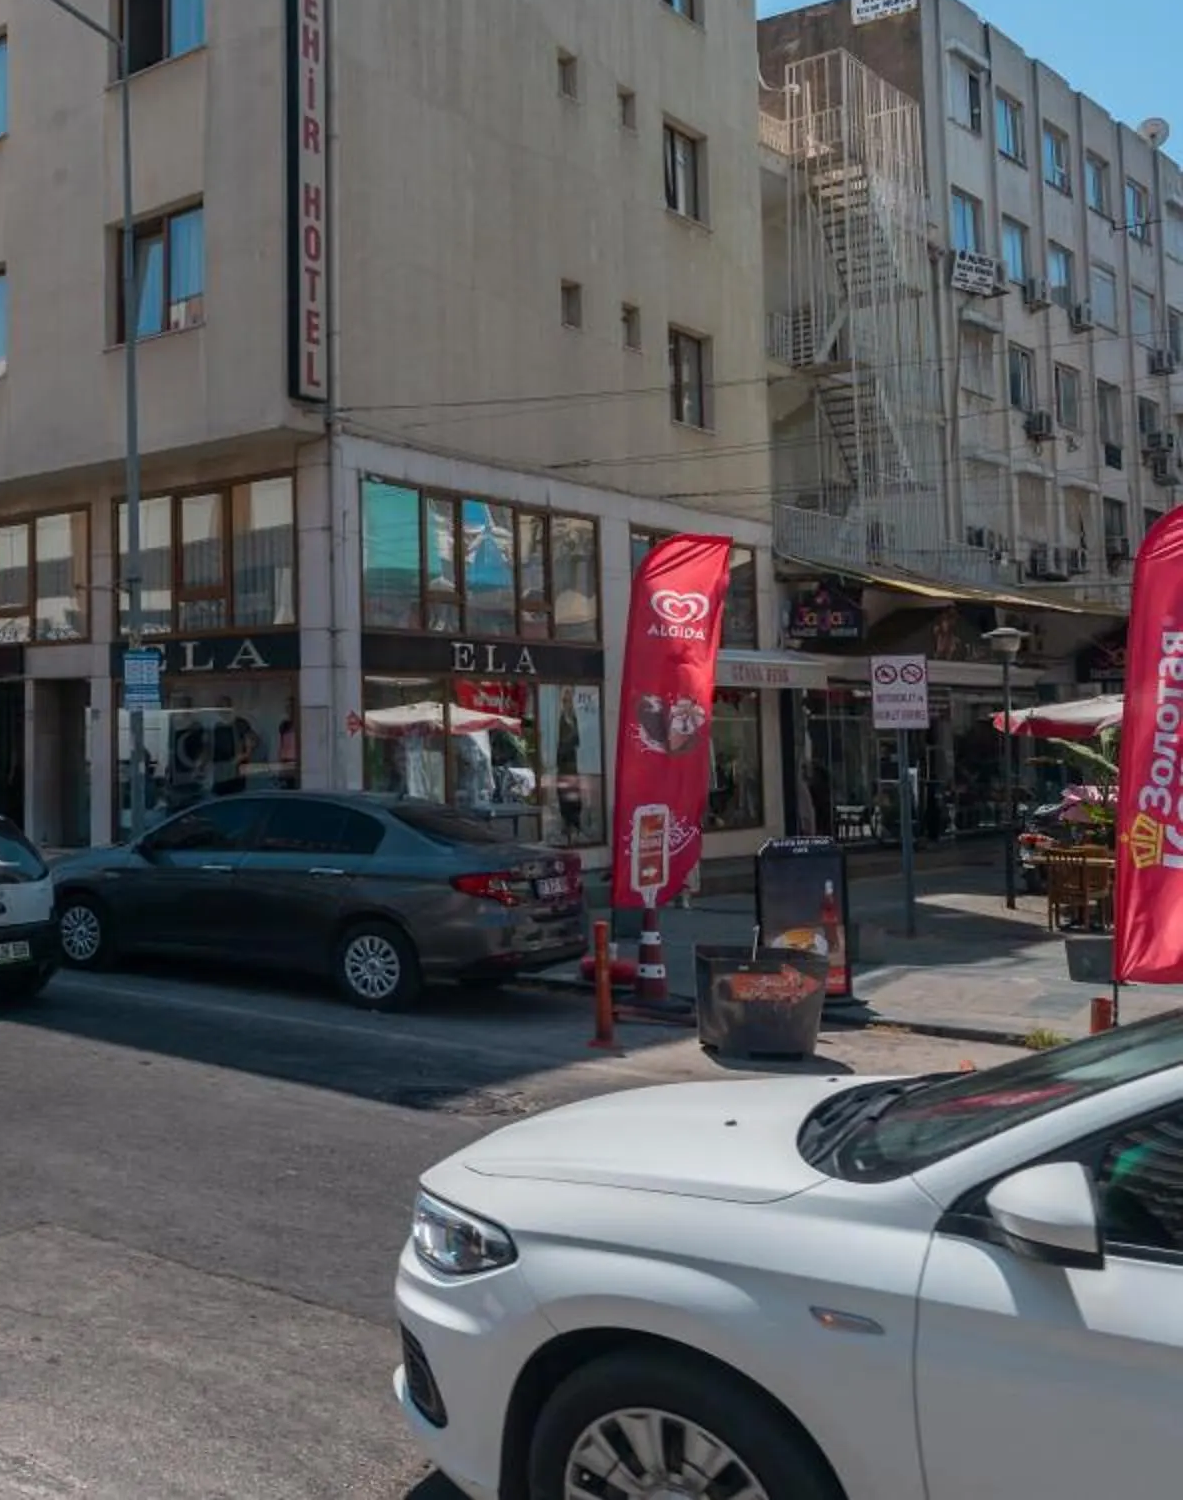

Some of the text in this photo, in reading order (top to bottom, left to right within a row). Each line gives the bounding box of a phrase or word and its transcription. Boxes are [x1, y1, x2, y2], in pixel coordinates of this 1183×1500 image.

[304, 182, 323, 388] HOTEL
[451, 642, 538, 675] ELA
[647, 623, 706, 642] ALGIDA
[1137, 631, 1183, 816] Золотая
